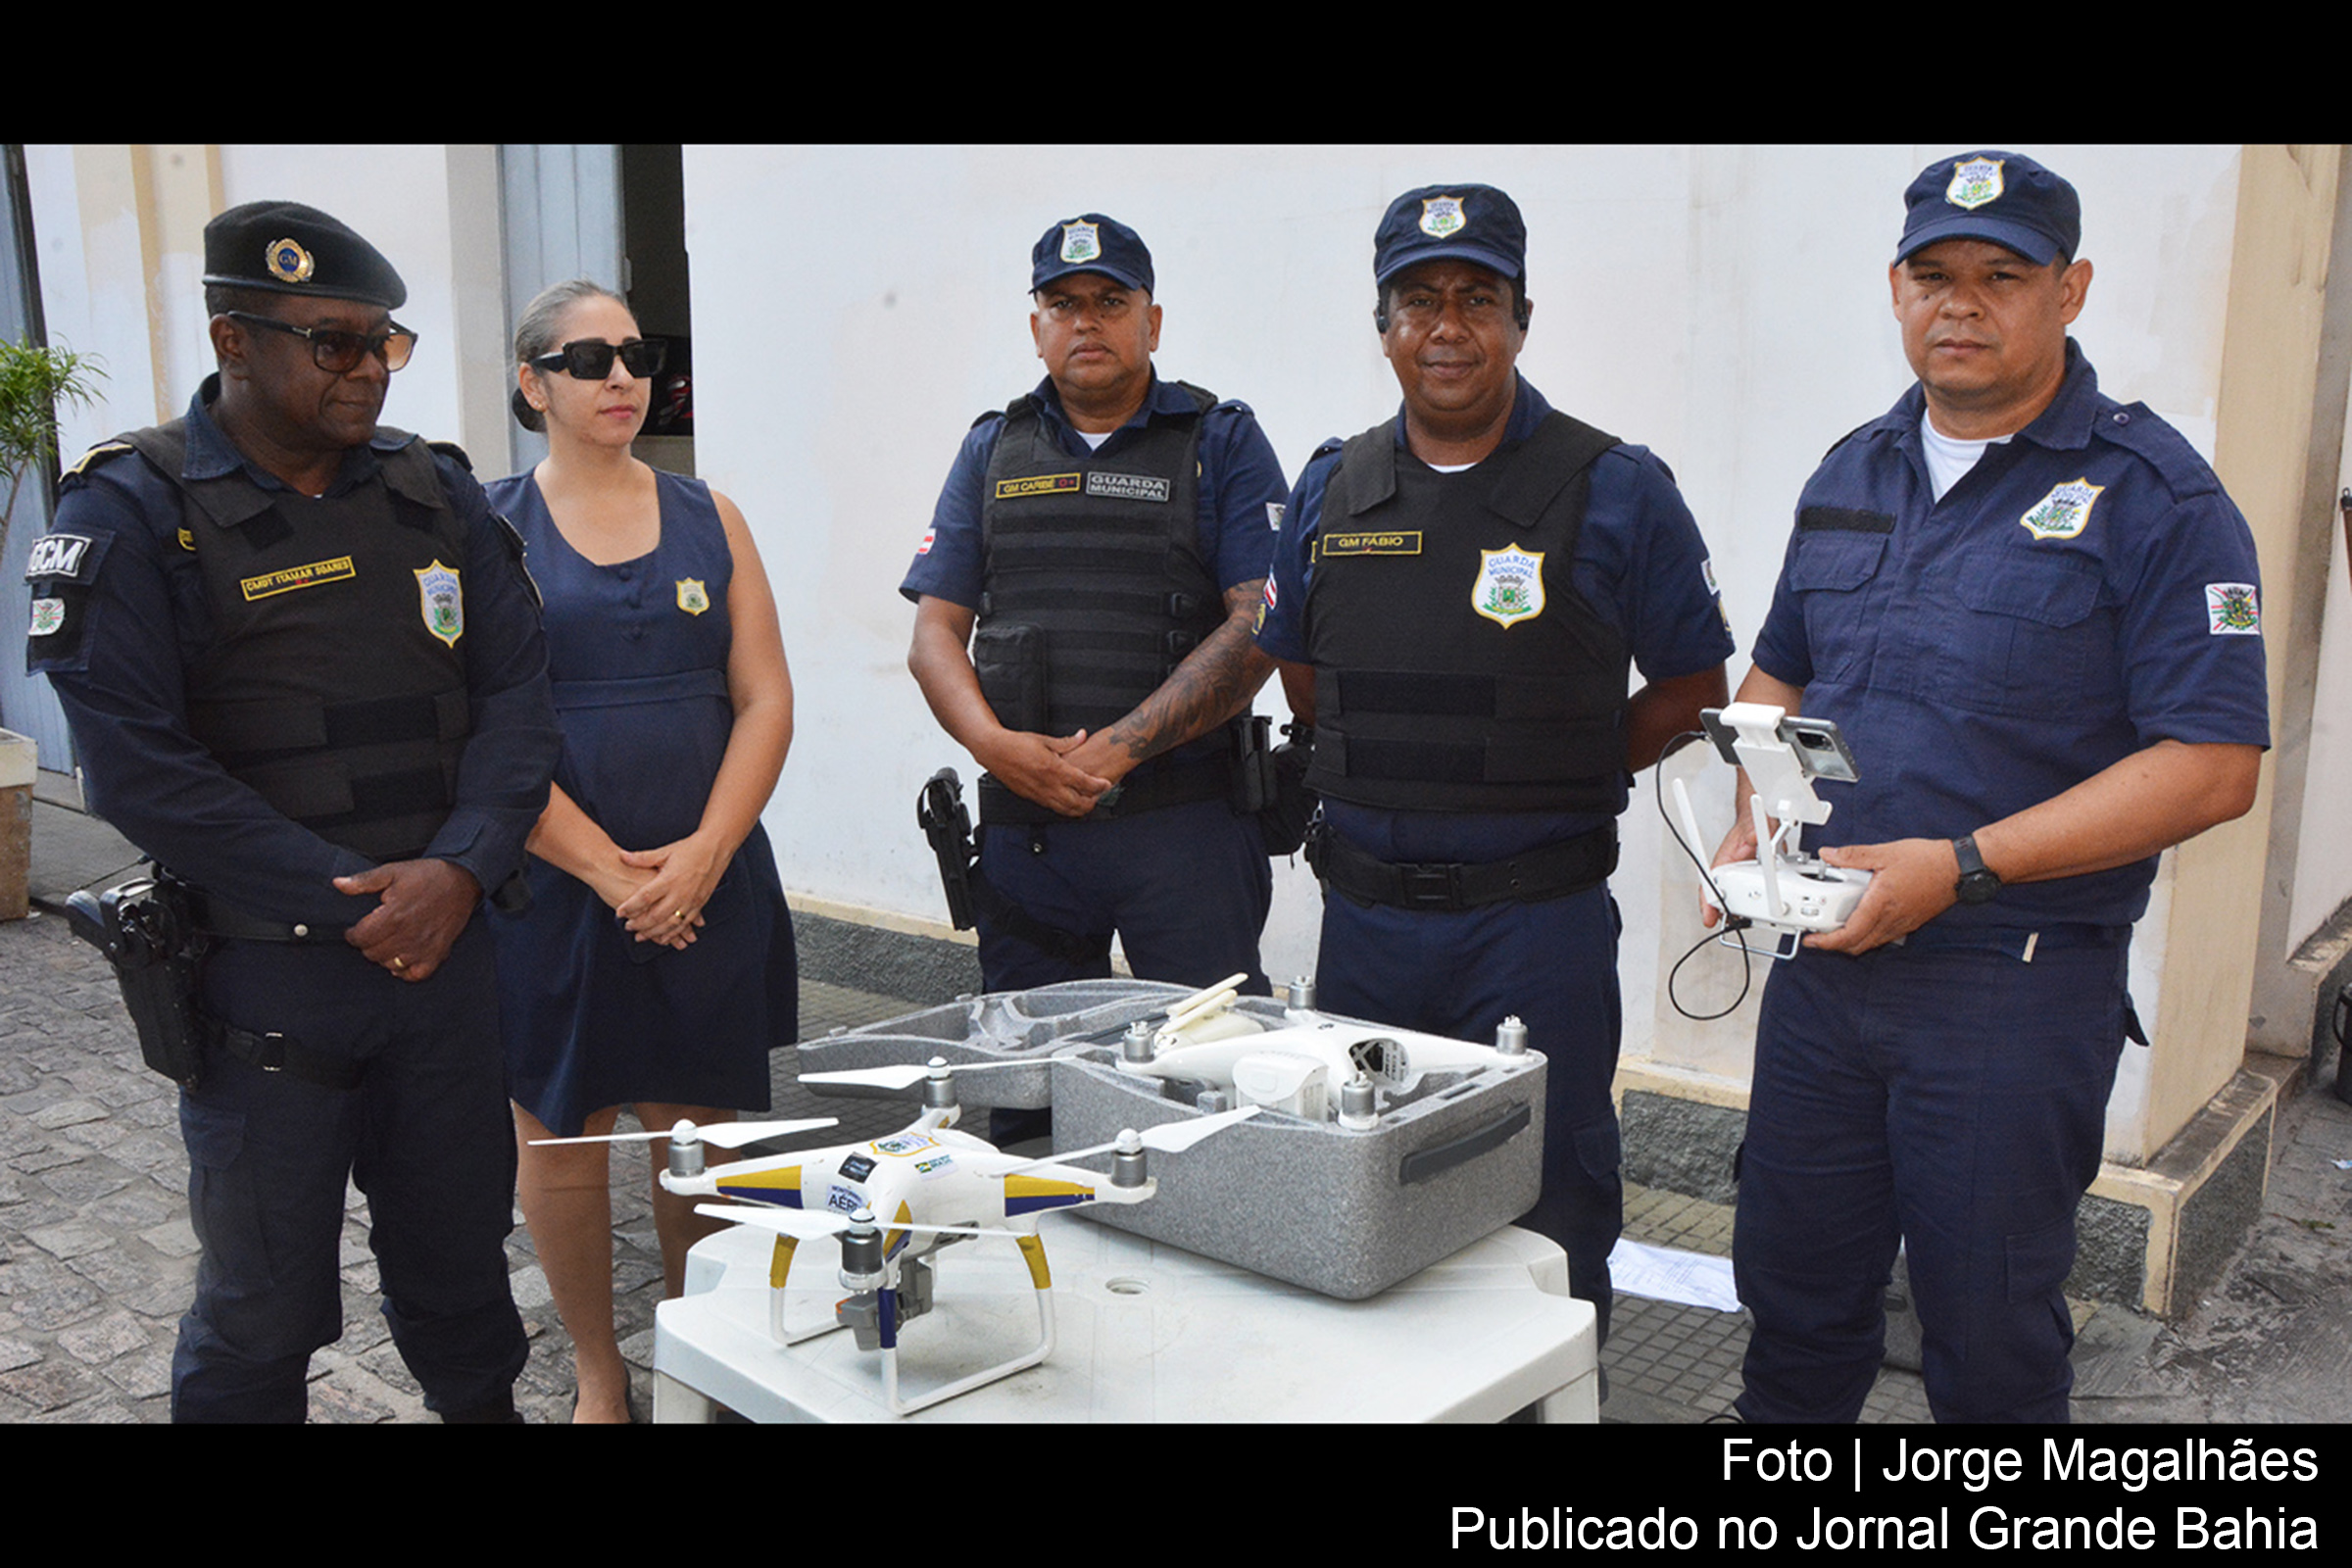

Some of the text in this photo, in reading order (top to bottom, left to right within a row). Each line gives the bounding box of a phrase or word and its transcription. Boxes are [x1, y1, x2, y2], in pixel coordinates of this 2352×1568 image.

[1004, 483, 1019, 493] GM
[1091, 474, 1165, 491] GUARDA
[1090, 484, 1164, 499] MUNICIPAL
[1339, 538, 1359, 548] GM
[1489, 555, 1535, 569] GUARDA
